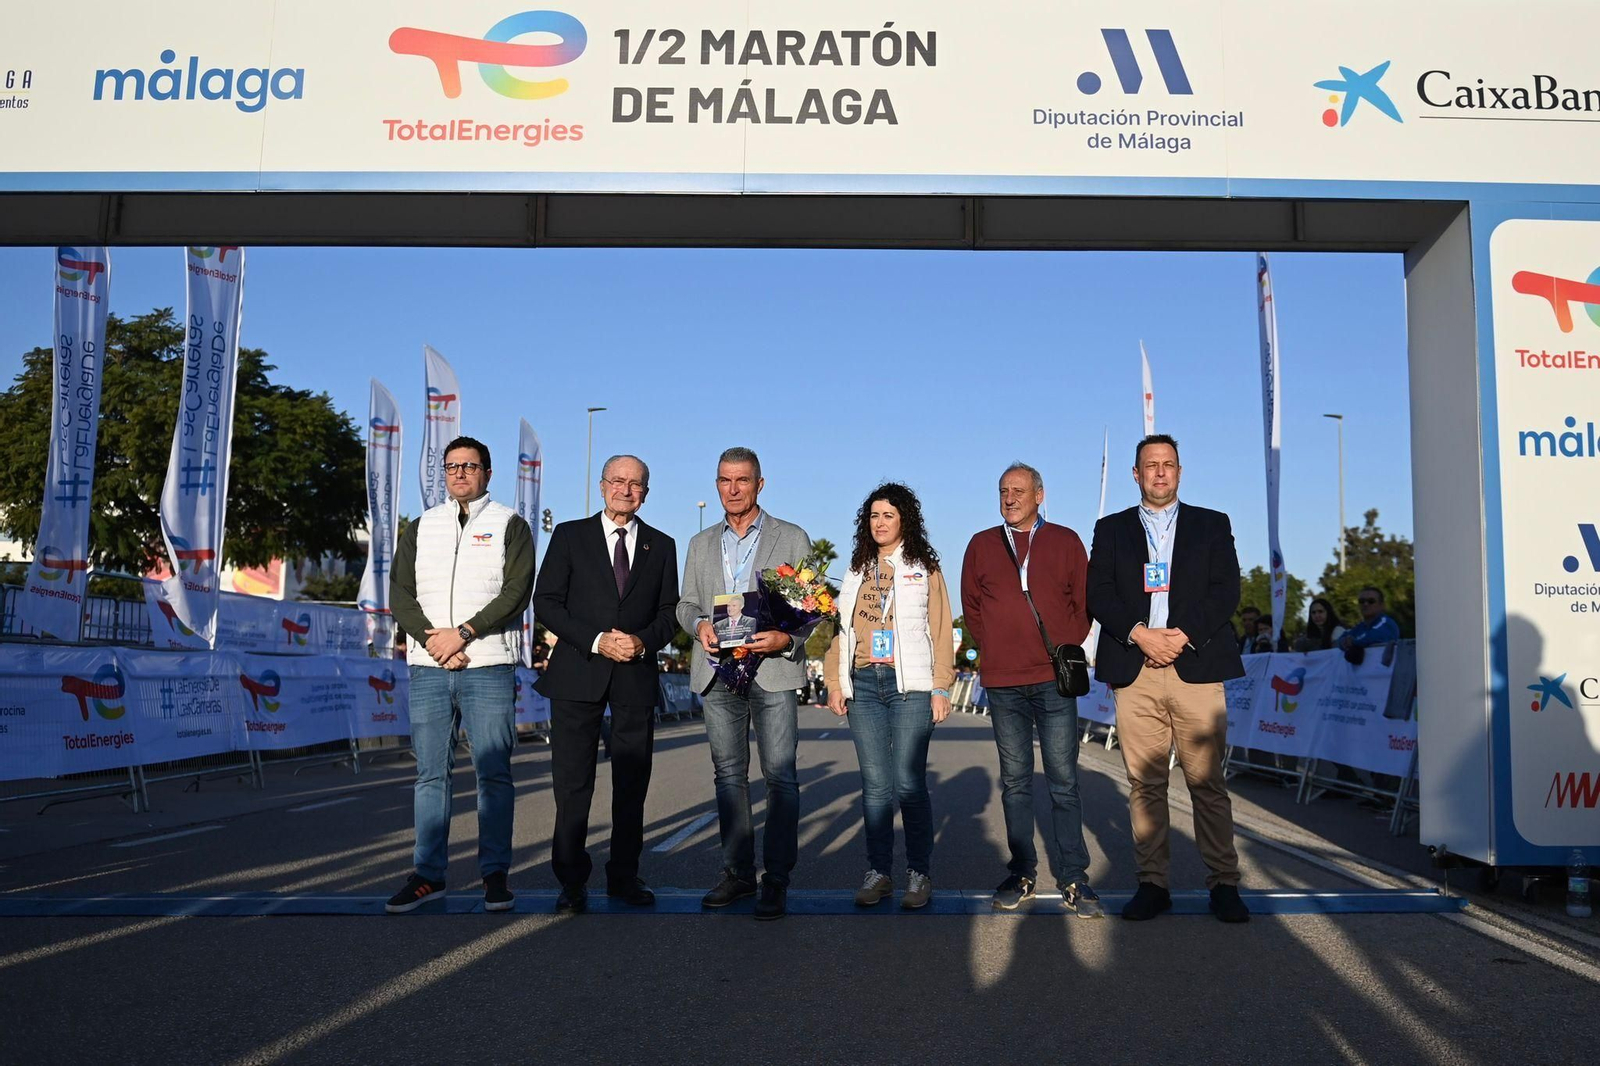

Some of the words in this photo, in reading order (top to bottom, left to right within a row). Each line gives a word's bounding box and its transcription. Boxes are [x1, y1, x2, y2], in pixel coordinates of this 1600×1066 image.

[613, 28, 686, 65] 1/2
[700, 21, 938, 67] MARATÓN
[612, 87, 675, 123] DE
[688, 79, 899, 125] MÁLAGA
[1033, 108, 1140, 128] Diputación
[1147, 111, 1244, 127] Provincial
[383, 119, 583, 147] TotalEnergies
[1087, 133, 1112, 149] de
[1119, 132, 1191, 153] Málaga
[1519, 416, 1600, 457] mál
[1534, 583, 1600, 598] Diputació
[1570, 601, 1587, 612] de
[63, 731, 135, 749] TotalEnergies
